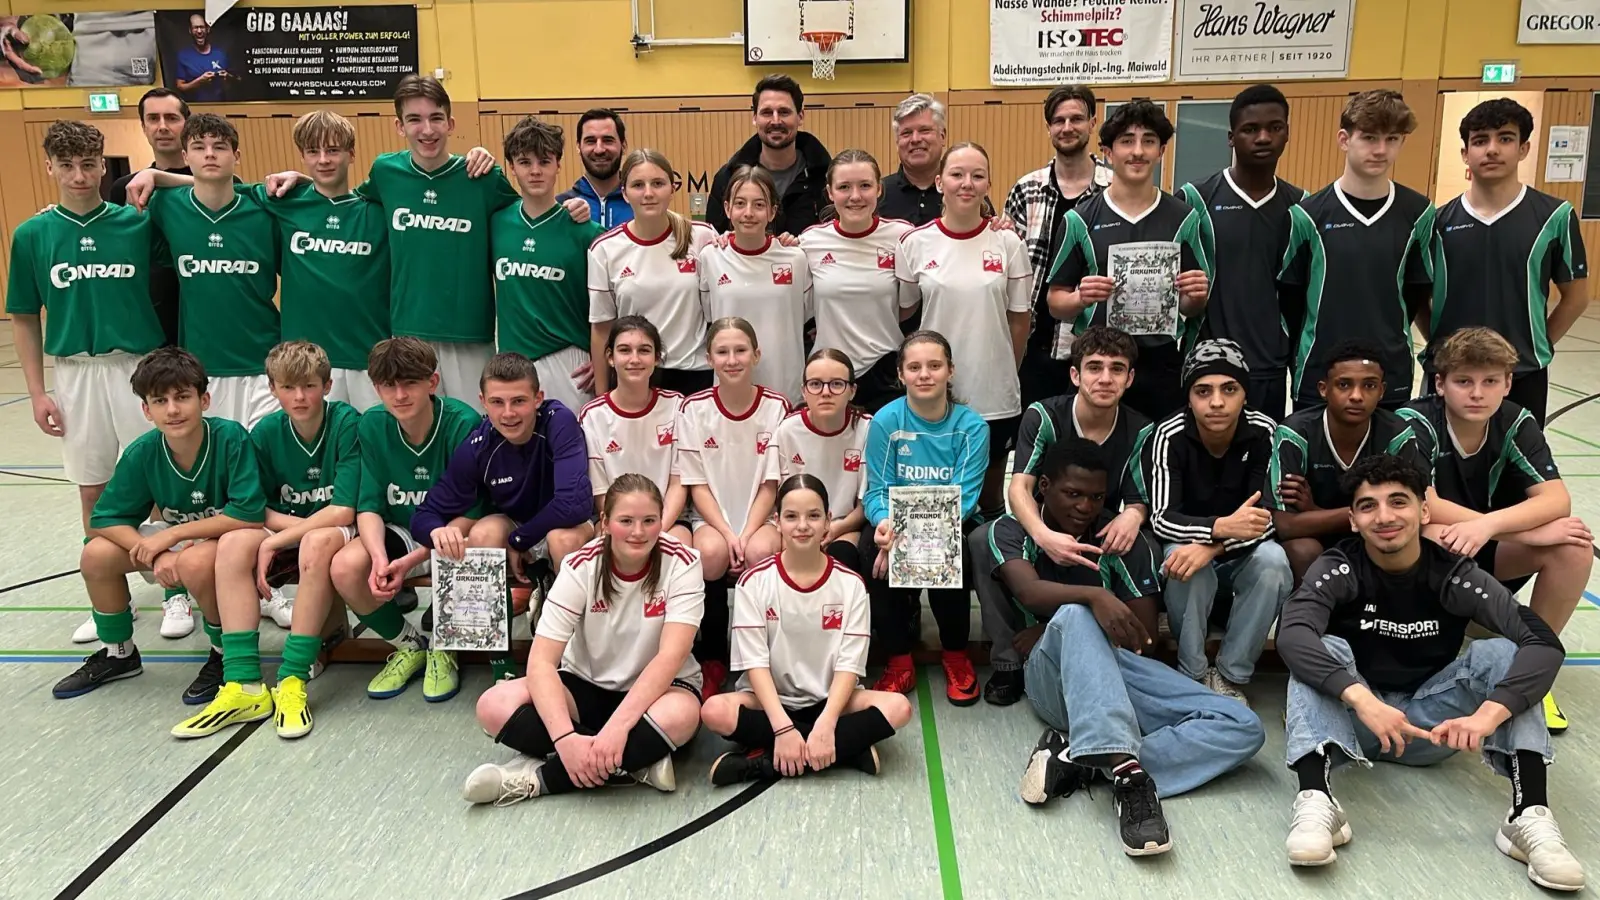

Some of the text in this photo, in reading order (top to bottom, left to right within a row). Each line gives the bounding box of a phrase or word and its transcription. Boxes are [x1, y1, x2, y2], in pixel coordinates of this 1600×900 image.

[246, 11, 348, 32] GIB GAAAAS!
[1041, 7, 1122, 23] Schimmelpilz?
[1194, 2, 1335, 39] Hans Wagner
[1527, 15, 1594, 30] GREGOR
[299, 33, 310, 41] MIT
[311, 32, 338, 41] VOLLER
[340, 32, 364, 40] POWER
[380, 30, 411, 40] ERFOLG!
[993, 60, 1167, 76] Abdichtungstechnik Dipl.-Ing. Maiwald
[1215, 54, 1267, 63] PARTNER
[1308, 52, 1332, 60] 1920
[392, 208, 472, 233] CONRAD
[290, 231, 372, 256] CONRAD
[50, 262, 136, 289] CONRAD
[178, 254, 260, 278] CONRAD
[496, 257, 566, 282] CONRAD
